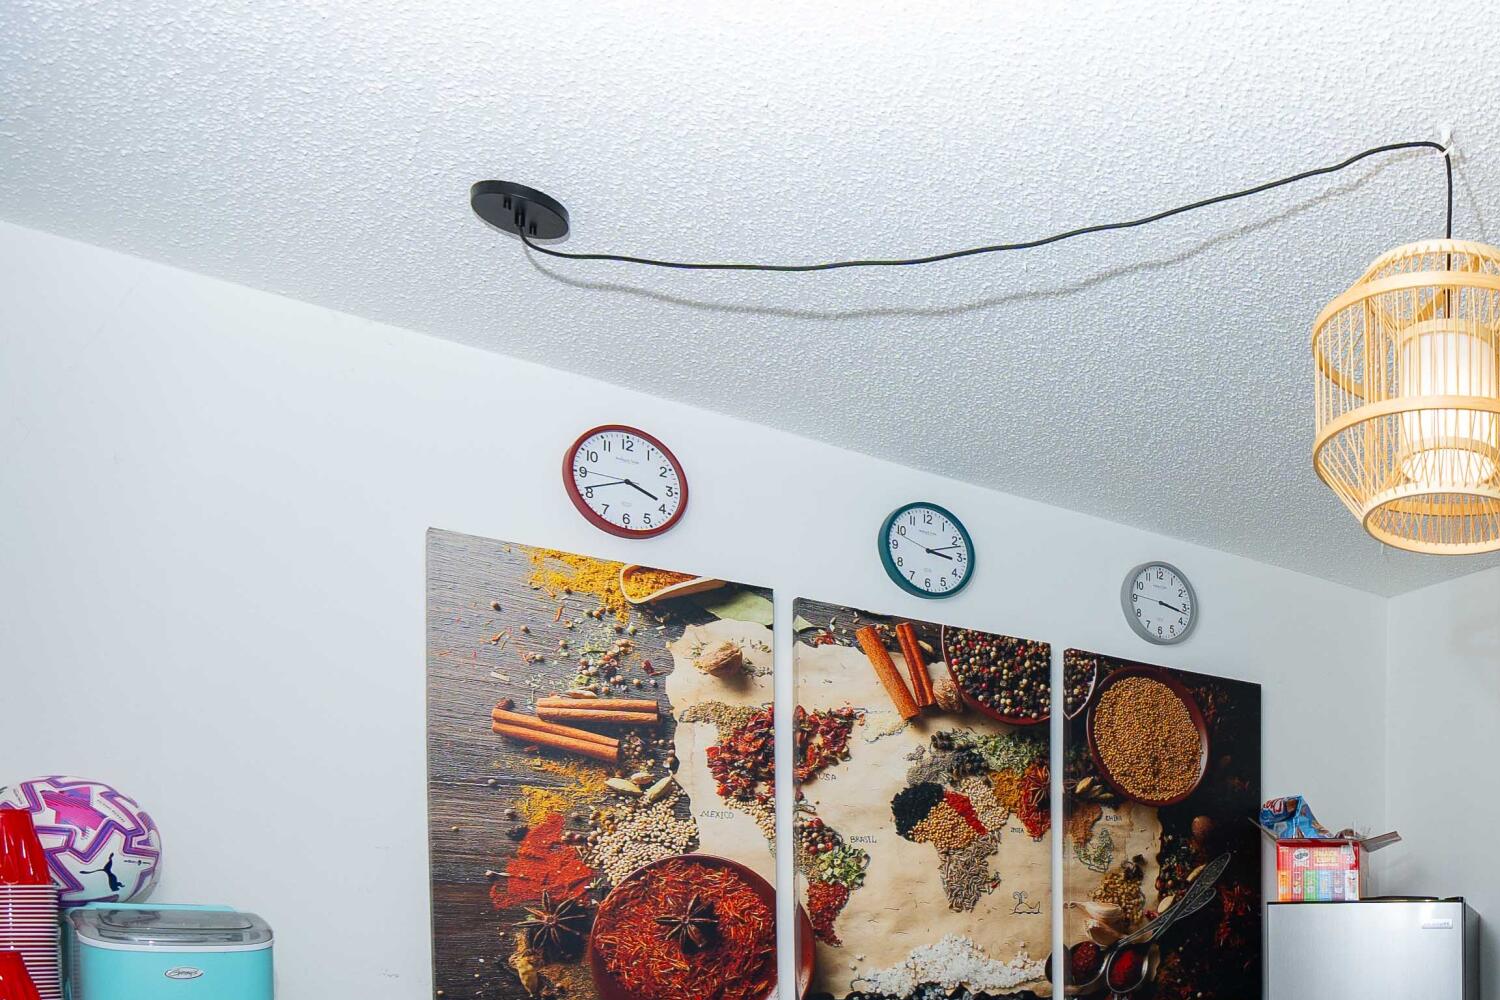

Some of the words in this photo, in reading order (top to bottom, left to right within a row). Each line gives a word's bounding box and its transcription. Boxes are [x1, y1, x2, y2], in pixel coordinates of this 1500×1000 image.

[603, 440, 610, 452] 11
[621, 439, 634, 452] 12
[586, 450, 598, 462] 10
[646, 450, 650, 461] 1
[579, 466, 588, 478] 9
[659, 466, 668, 478] 2
[586, 487, 594, 498] 8
[666, 486, 674, 497] 3
[602, 504, 610, 514] 7
[658, 504, 666, 514] 4
[622, 514, 630, 524] 6
[643, 513, 652, 524] 5
[910, 516, 916, 526] 11
[923, 514, 933, 524] 12
[896, 525, 906, 536] 10
[942, 522, 945, 532] 1
[892, 540, 898, 550] 9
[952, 536, 958, 546] 2
[896, 557, 904, 566] 8
[956, 553, 962, 562] 3
[909, 570, 916, 580] 7
[952, 568, 958, 578] 4
[924, 578, 930, 588] 6
[940, 577, 946, 586] 5
[818, 773, 836, 781] USA
[700, 810, 735, 820] MEXICO
[850, 836, 877, 844] BRASIL
